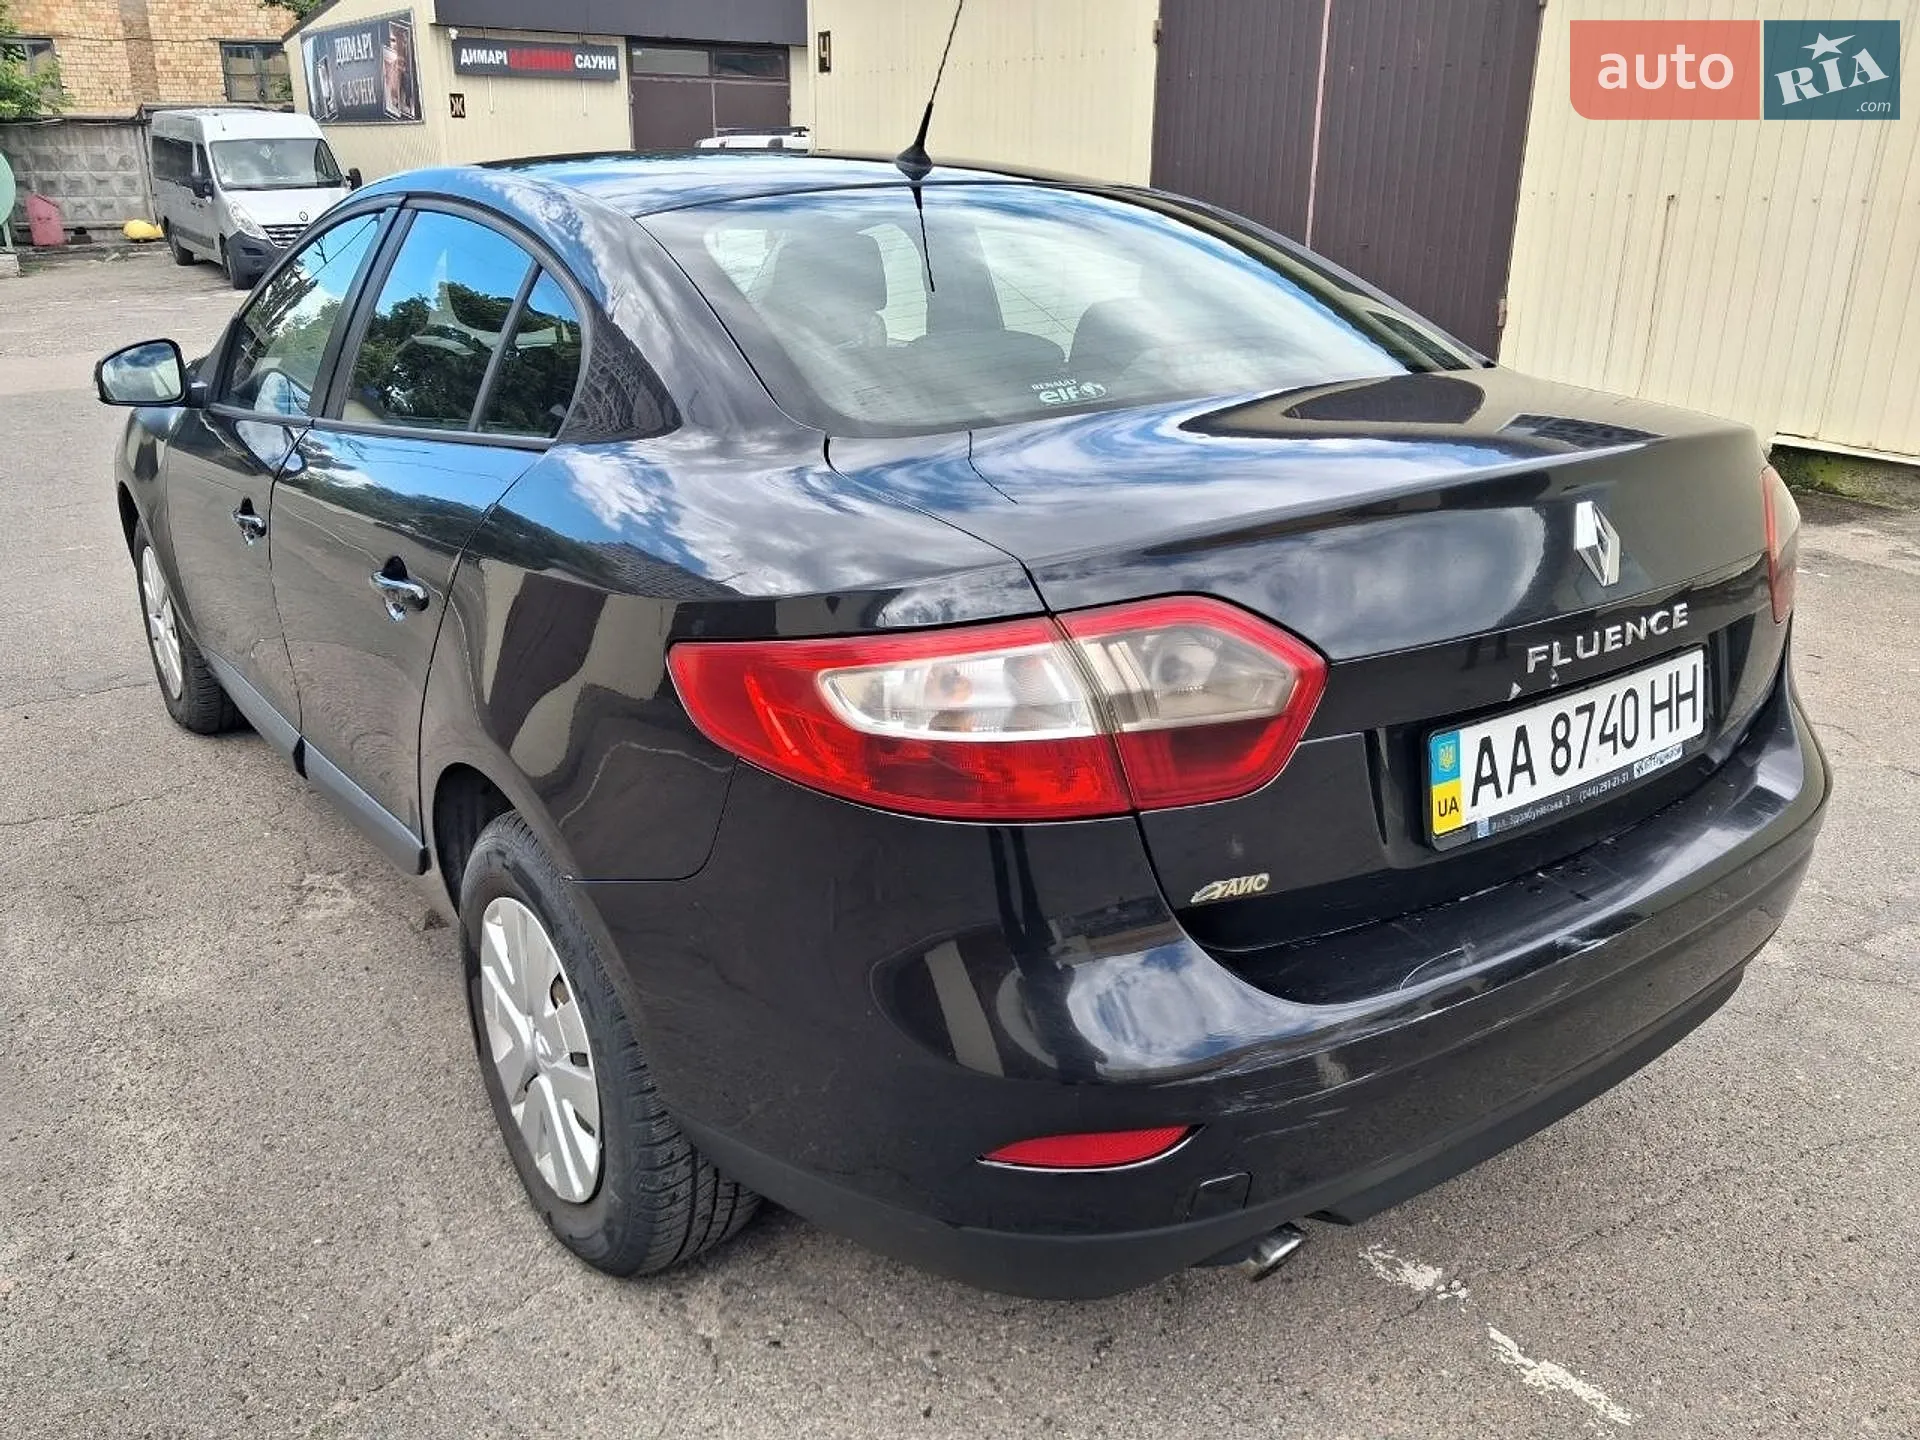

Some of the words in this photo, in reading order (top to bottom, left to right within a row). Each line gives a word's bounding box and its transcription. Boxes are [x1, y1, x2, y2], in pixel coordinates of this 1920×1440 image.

[334, 32, 374, 63] ДИМАРІ
[460, 48, 508, 66] ДИМАРІ
[575, 53, 617, 70] САУНИ
[340, 76, 377, 107] САУНИ
[451, 96, 465, 116] Ж
[1040, 386, 1081, 403] elf
[1526, 602, 1689, 673] FLUENCE
[1471, 724, 1538, 807] AA
[1550, 687, 1640, 777] 8740
[1650, 663, 1698, 741] HH
[1438, 796, 1460, 818] UA
